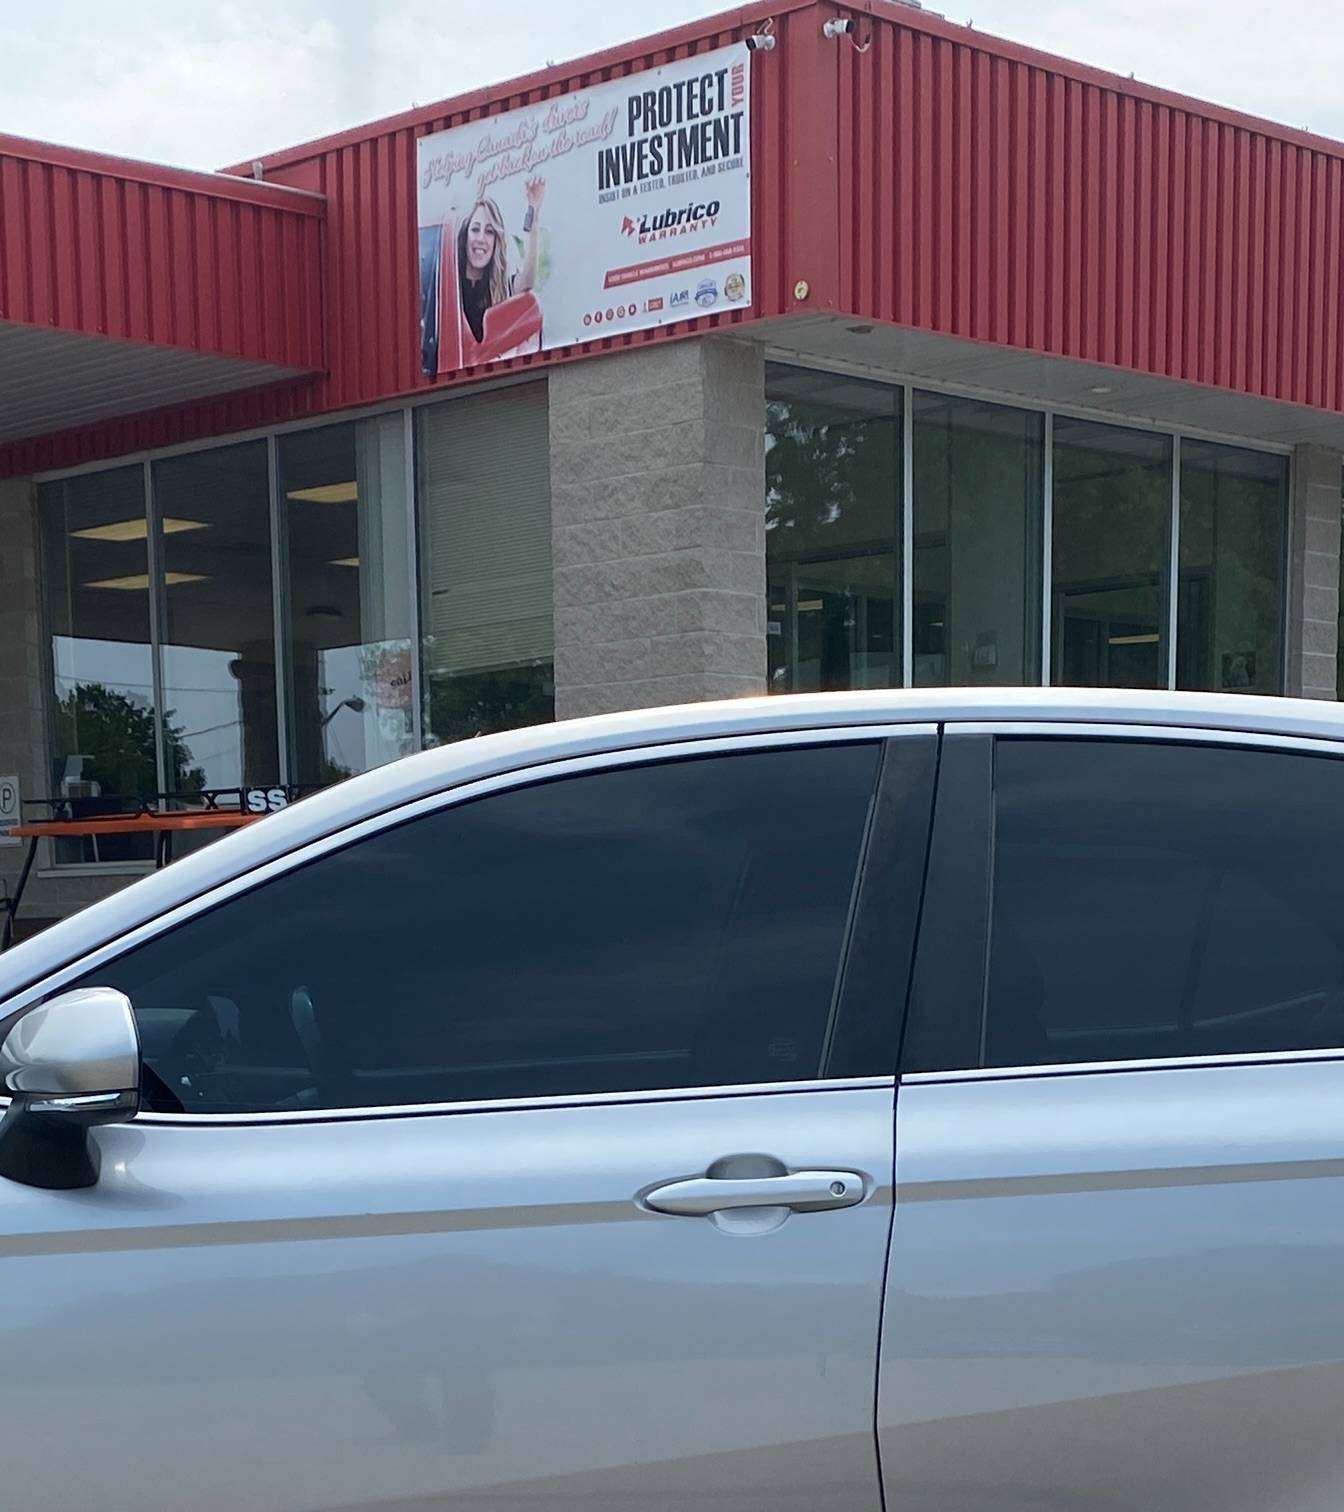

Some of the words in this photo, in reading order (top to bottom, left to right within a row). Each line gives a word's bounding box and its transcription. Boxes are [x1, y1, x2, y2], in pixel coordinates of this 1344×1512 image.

[627, 67, 728, 137] PROTECT
[731, 63, 745, 108] YOUR
[598, 111, 744, 190] INVESTMENT
[632, 184, 639, 196] A
[701, 163, 716, 177] AND
[717, 157, 745, 173] SECURE
[638, 217, 719, 245] WARRANTY
[639, 200, 720, 234] Lubrico
[247, 788, 289, 813] SS
